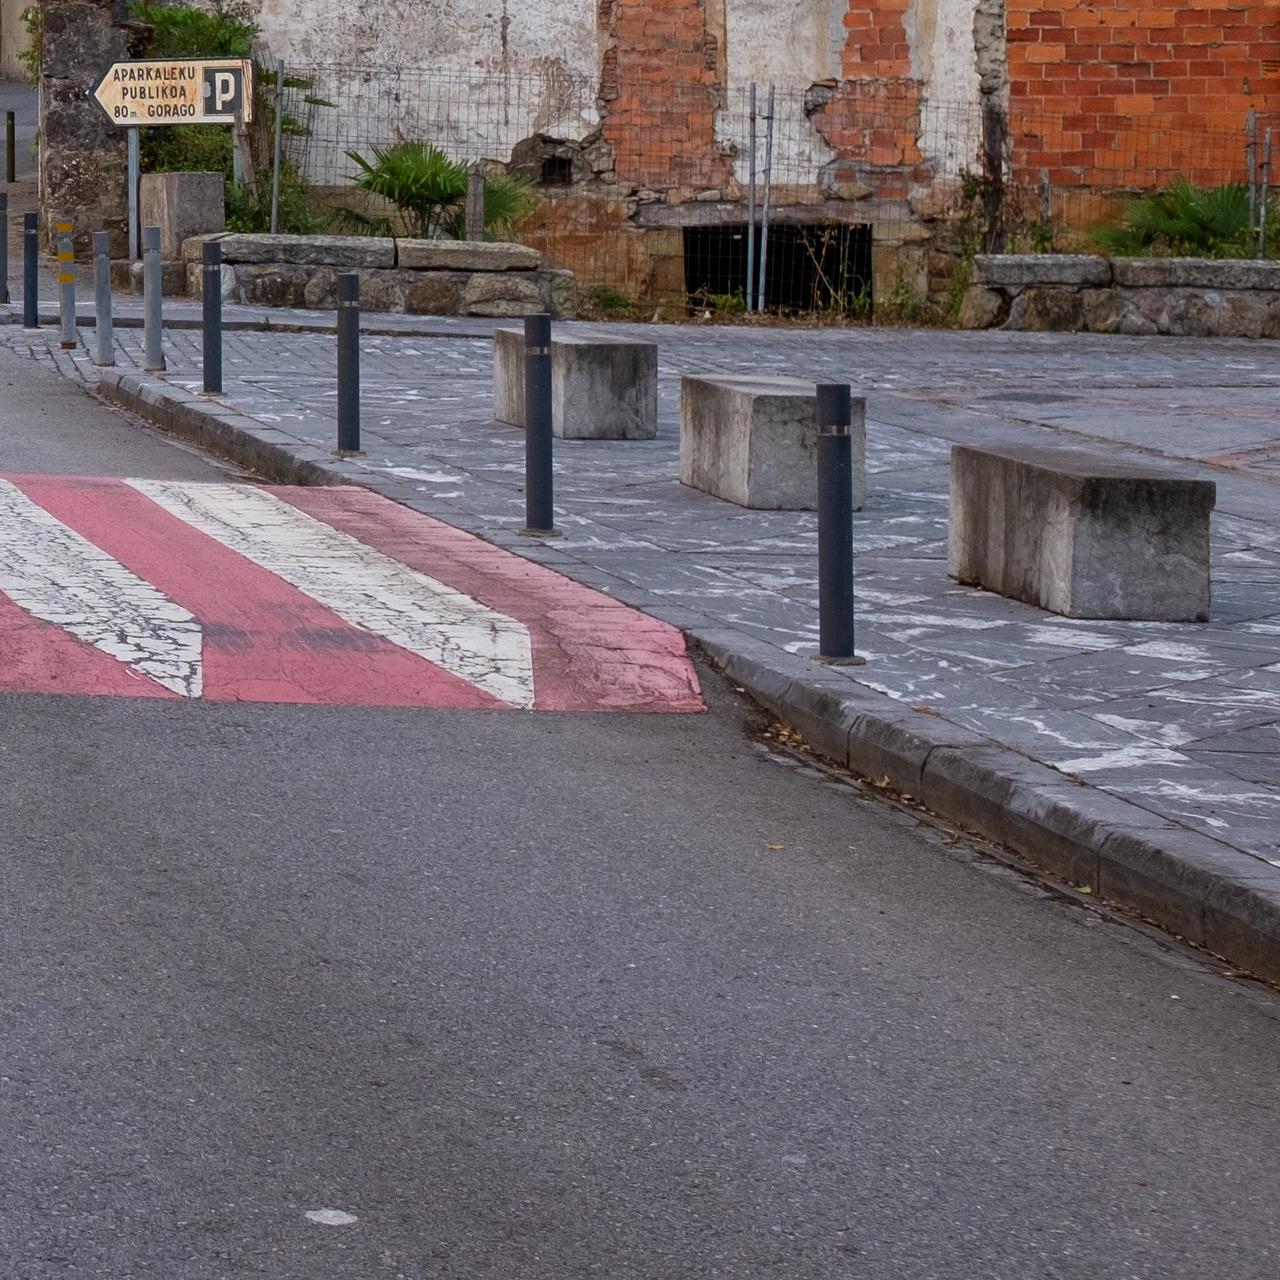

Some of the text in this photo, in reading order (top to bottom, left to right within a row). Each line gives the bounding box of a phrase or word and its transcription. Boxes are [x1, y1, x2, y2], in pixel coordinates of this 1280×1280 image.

[113, 66, 196, 82] APARKALEKU
[122, 85, 187, 100] PUBLIKOA
[214, 72, 236, 111] P
[147, 104, 196, 118] GORAGO
